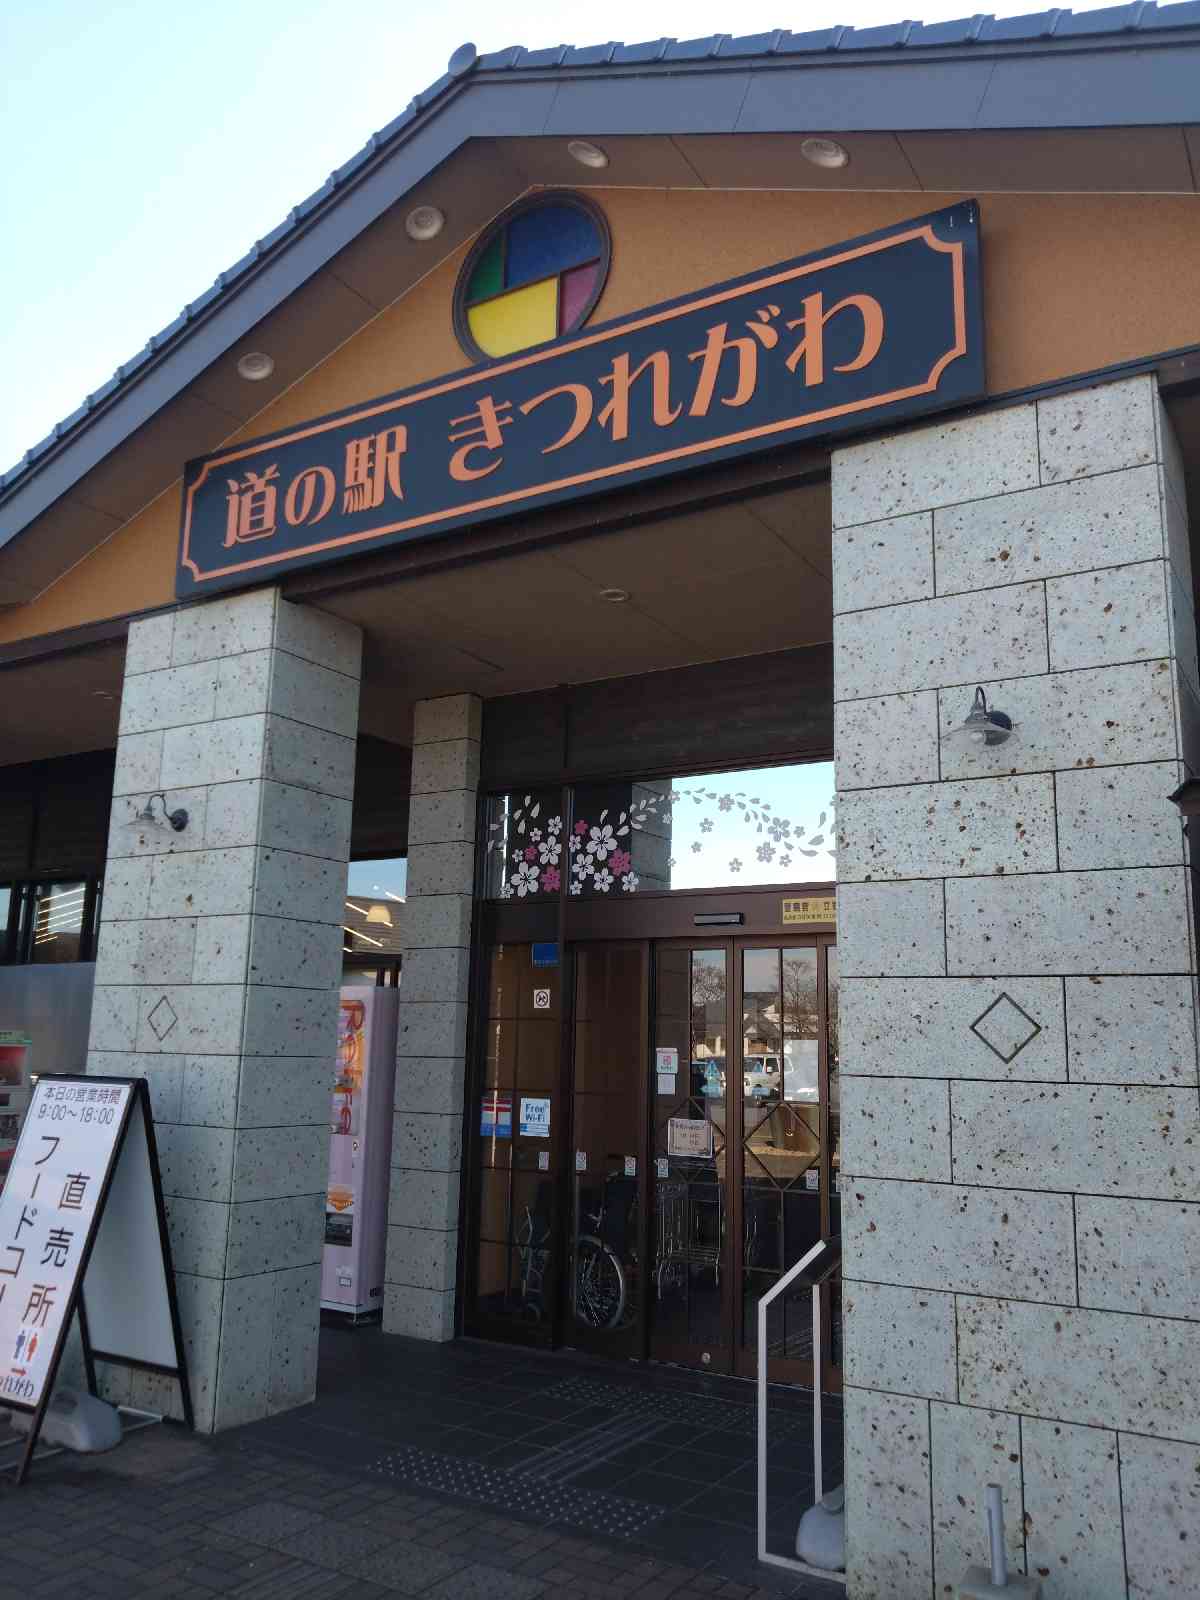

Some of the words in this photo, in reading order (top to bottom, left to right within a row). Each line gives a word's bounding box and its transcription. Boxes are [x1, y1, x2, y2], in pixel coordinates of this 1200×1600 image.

[223, 423, 407, 549] 道の駅
[449, 291, 885, 481] きつれがわ
[43, 1087, 121, 1104] 本日の営業時間
[525, 1104, 545, 1113] Free
[22, 1172, 91, 1328] 直売所
